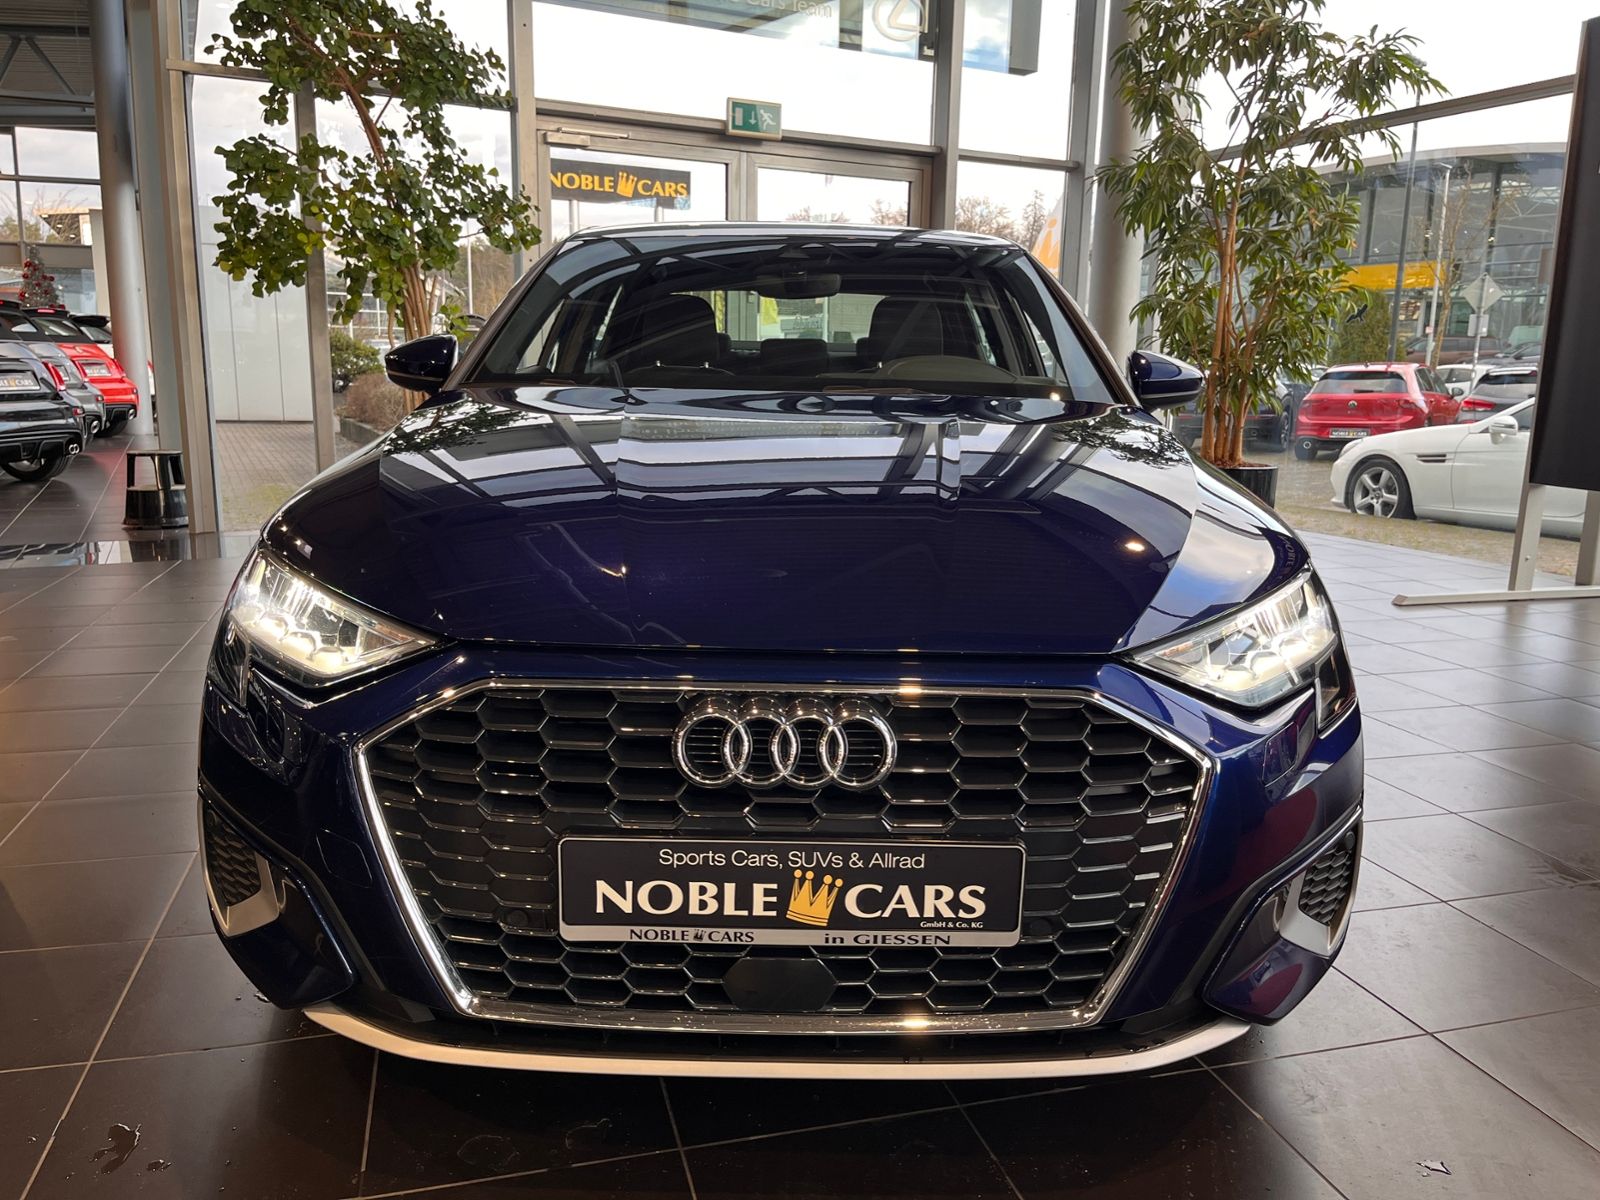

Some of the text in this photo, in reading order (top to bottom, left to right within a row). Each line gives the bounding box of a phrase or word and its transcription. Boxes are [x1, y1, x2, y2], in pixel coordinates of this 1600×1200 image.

[550, 172, 688, 197] NOBLE CARS
[659, 848, 925, 869] Sports Cars, SUVs & Allrad
[595, 879, 987, 919] NOBLE CARS
[630, 929, 950, 945] NOBLE CARS in GIESSEN
